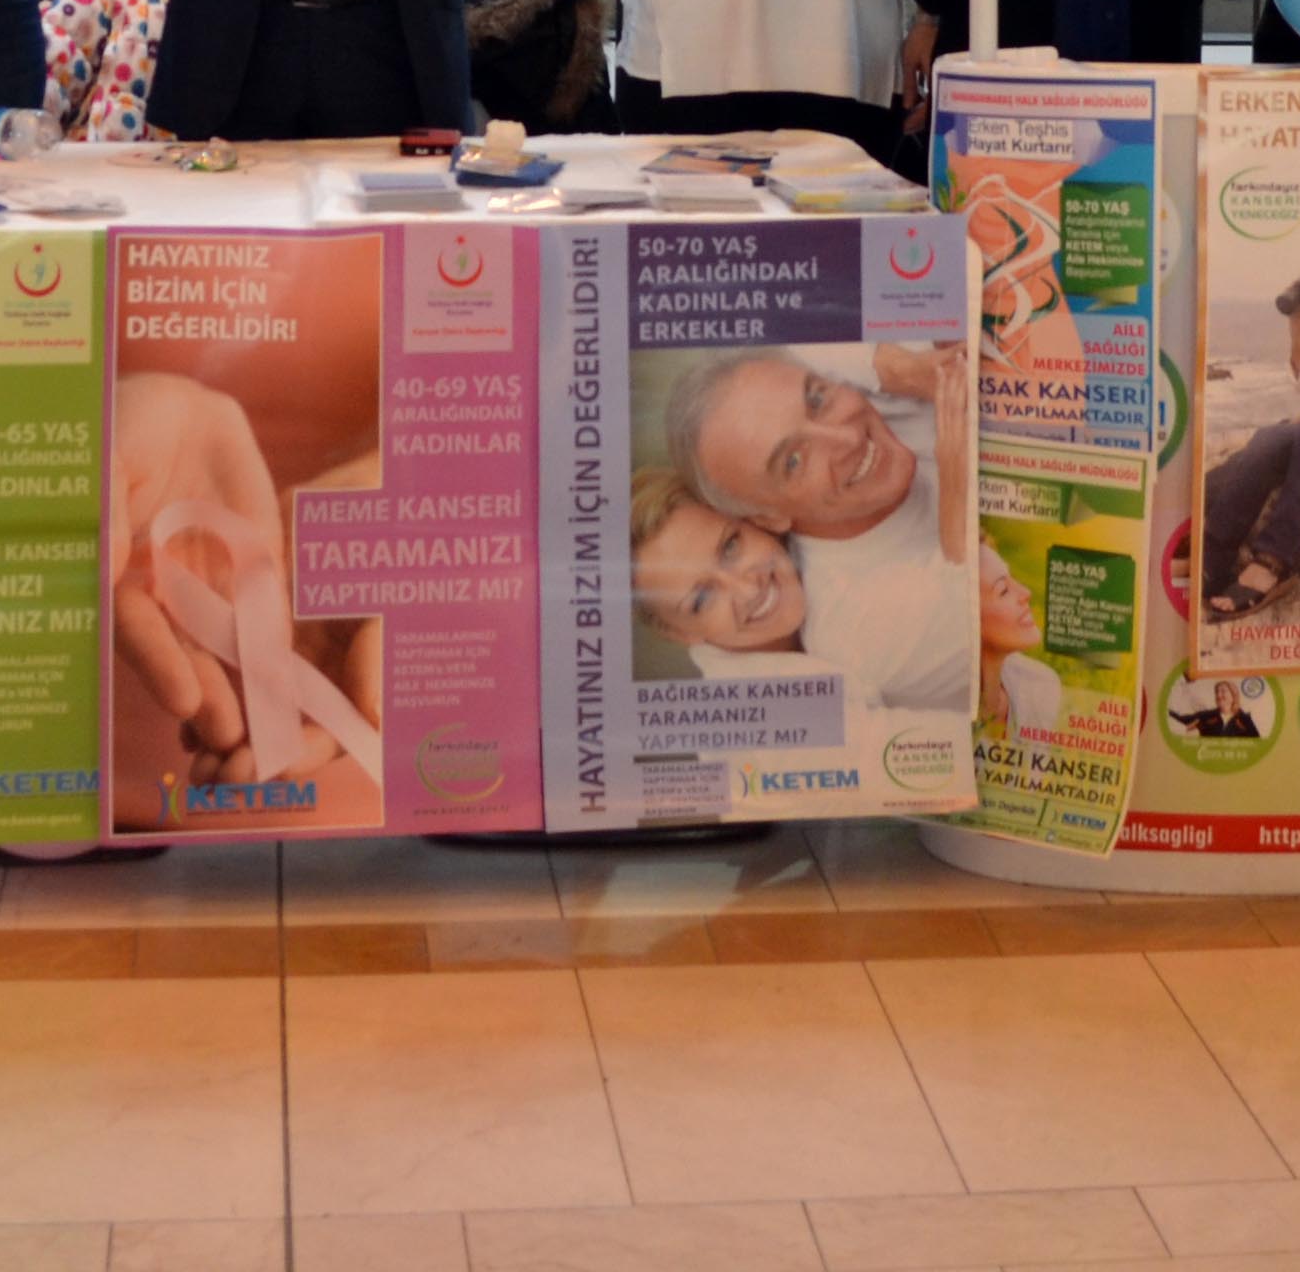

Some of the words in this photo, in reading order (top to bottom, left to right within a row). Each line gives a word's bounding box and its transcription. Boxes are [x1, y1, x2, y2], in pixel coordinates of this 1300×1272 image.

[127, 245, 270, 269] HAYATINIZ
[638, 237, 704, 258] 50-70
[710, 236, 758, 259] YAŞ
[638, 257, 818, 284] ARALIĞINDAKİ
[127, 276, 204, 304] BİZİM
[212, 277, 267, 310] İÇİN
[638, 290, 766, 314] KADINLAR
[775, 293, 803, 310] ve
[126, 312, 297, 342] DEĞERLİDİR!
[638, 319, 765, 342] ERKEKLER
[1113, 322, 1145, 338] AİLE
[567, 237, 600, 450] DEĞERLİDİR!
[1083, 339, 1145, 357] SAĞLIĞI
[392, 377, 467, 400] 40-69
[472, 375, 522, 402] YAŞ
[43, 422, 90, 448] YAŞ
[392, 433, 521, 456] KADINLAR
[568, 460, 609, 525] İÇİN
[302, 498, 389, 524] MEME
[399, 491, 522, 521] KANSERİ
[302, 536, 522, 570] TARAMANIZI
[303, 578, 471, 607] YAPTIRDINIZ
[479, 577, 523, 603] MI?
[569, 533, 603, 628] BİZİM
[49, 609, 96, 632] MI?
[637, 683, 740, 705] BAĞIRSAK
[747, 676, 836, 699] KANSERİ
[576, 638, 606, 814] HAYATINIZ
[637, 707, 767, 728] TARAMANIZI
[638, 730, 768, 751] YAPTIRDINIZ
[774, 728, 808, 746] MI?
[761, 769, 860, 793] KETEM
[1031, 751, 1121, 787] KANSERİ
[187, 781, 317, 811] KETEM
